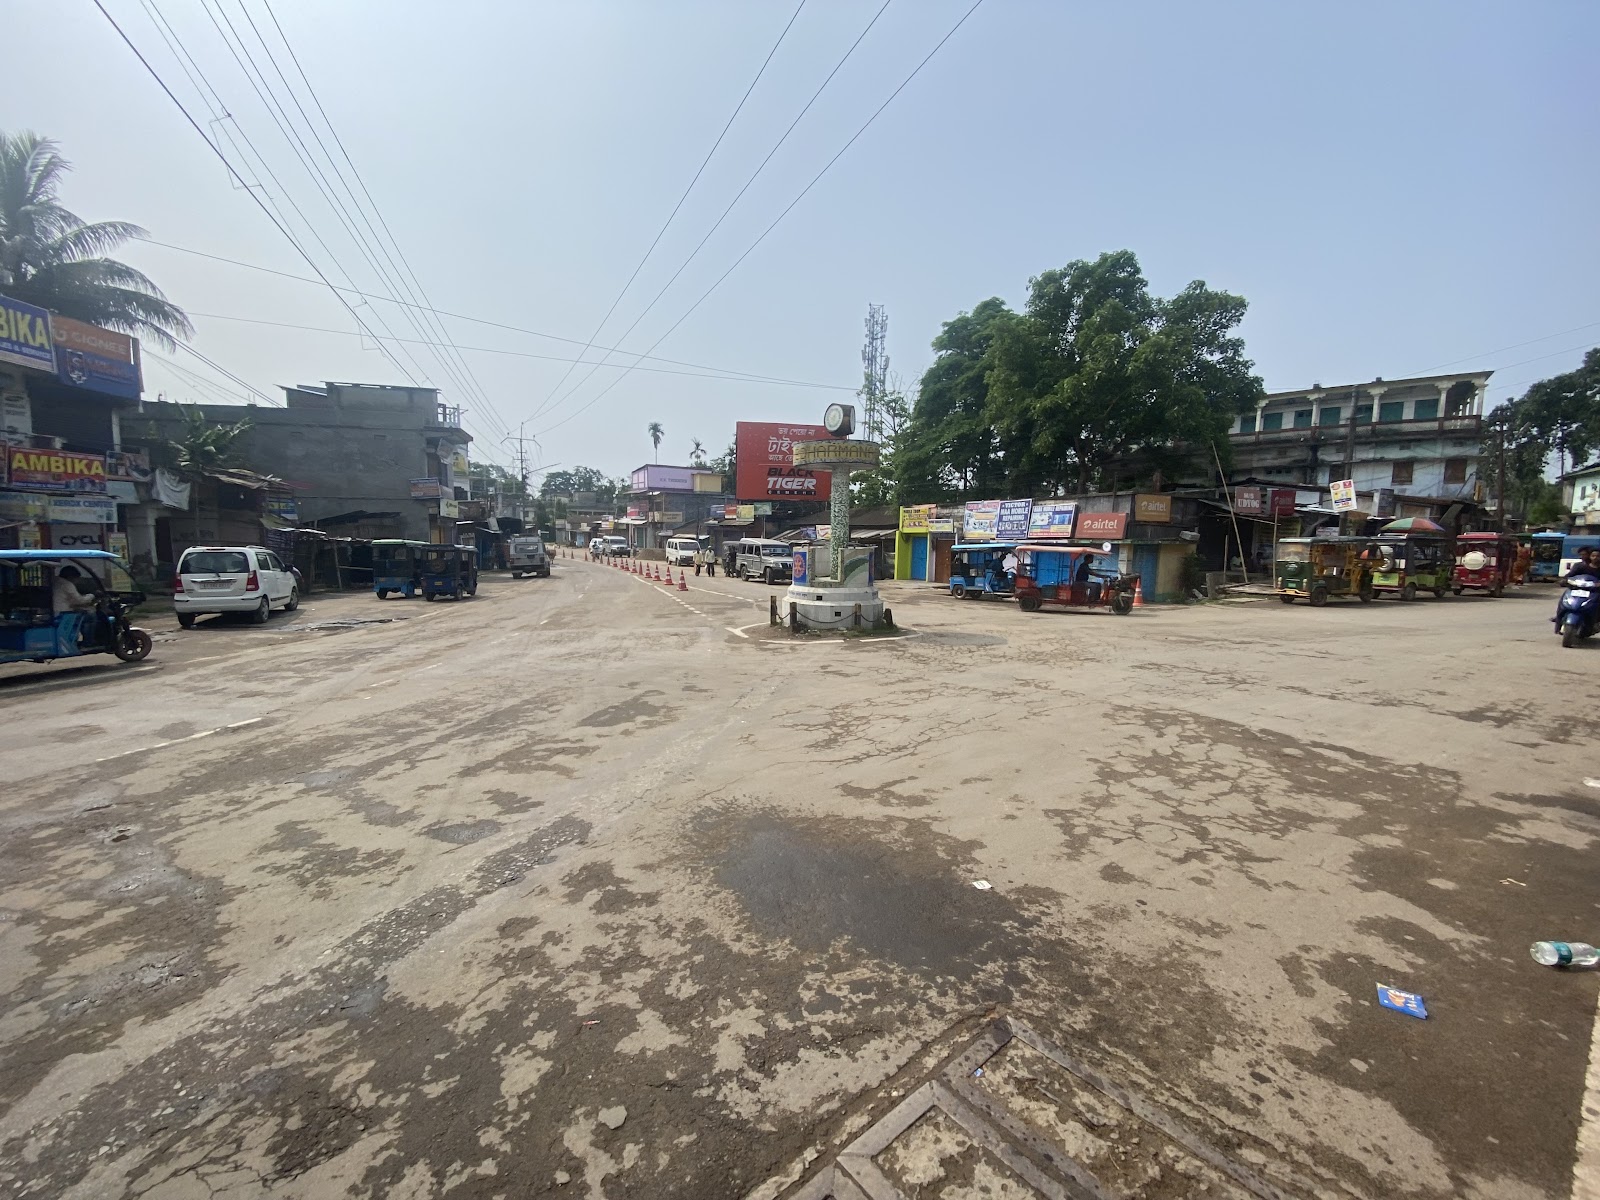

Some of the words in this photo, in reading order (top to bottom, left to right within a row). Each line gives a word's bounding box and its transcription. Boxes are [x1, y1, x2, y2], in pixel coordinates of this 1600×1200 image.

[12, 452, 105, 475] AMBIKA
[767, 467, 814, 478] BLACK
[767, 477, 817, 490] TIGER
[1148, 500, 1166, 511] airtel
[1238, 498, 1260, 508] UDYOG
[1092, 519, 1117, 529] airtel
[60, 534, 102, 546] CYCL
